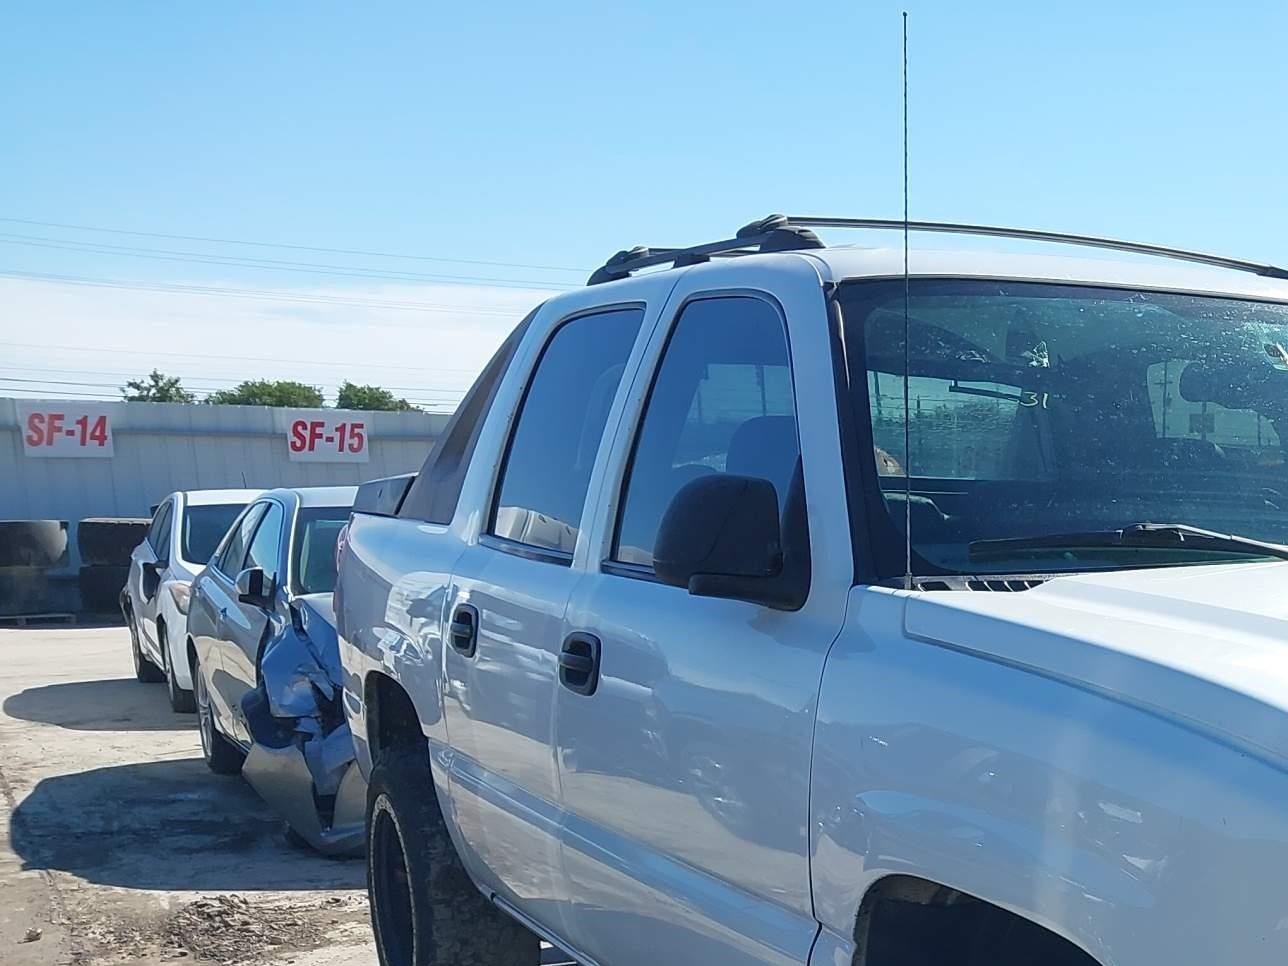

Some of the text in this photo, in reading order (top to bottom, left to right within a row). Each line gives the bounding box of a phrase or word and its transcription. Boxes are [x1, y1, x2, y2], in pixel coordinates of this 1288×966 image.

[1019, 391, 1049, 409] 31
[26, 413, 108, 447] SF-14
[290, 420, 365, 453] SF-15
